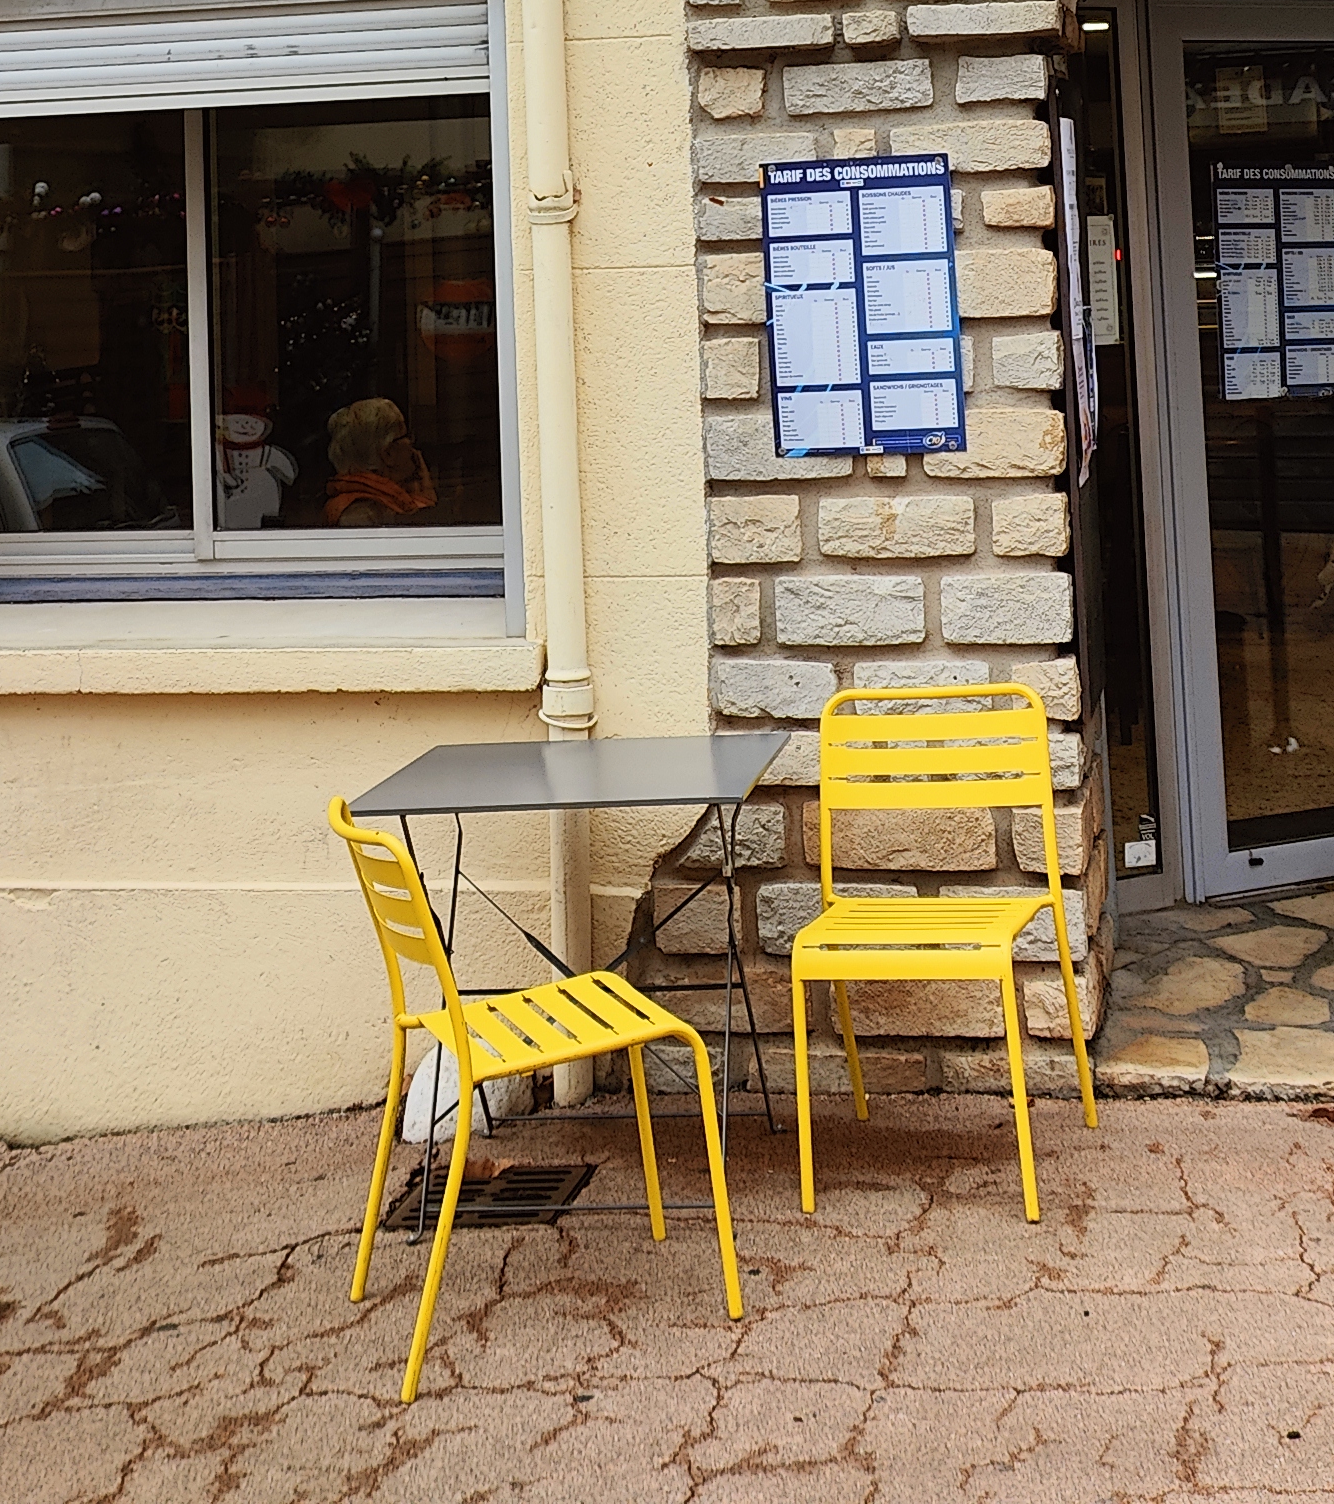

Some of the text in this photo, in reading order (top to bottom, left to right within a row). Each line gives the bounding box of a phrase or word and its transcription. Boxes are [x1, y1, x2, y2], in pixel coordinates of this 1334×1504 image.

[768, 161, 945, 184] TARIF DES CONSOMMATIONS
[1217, 168, 1334, 179] TARIF DES CONSOMMATIONS
